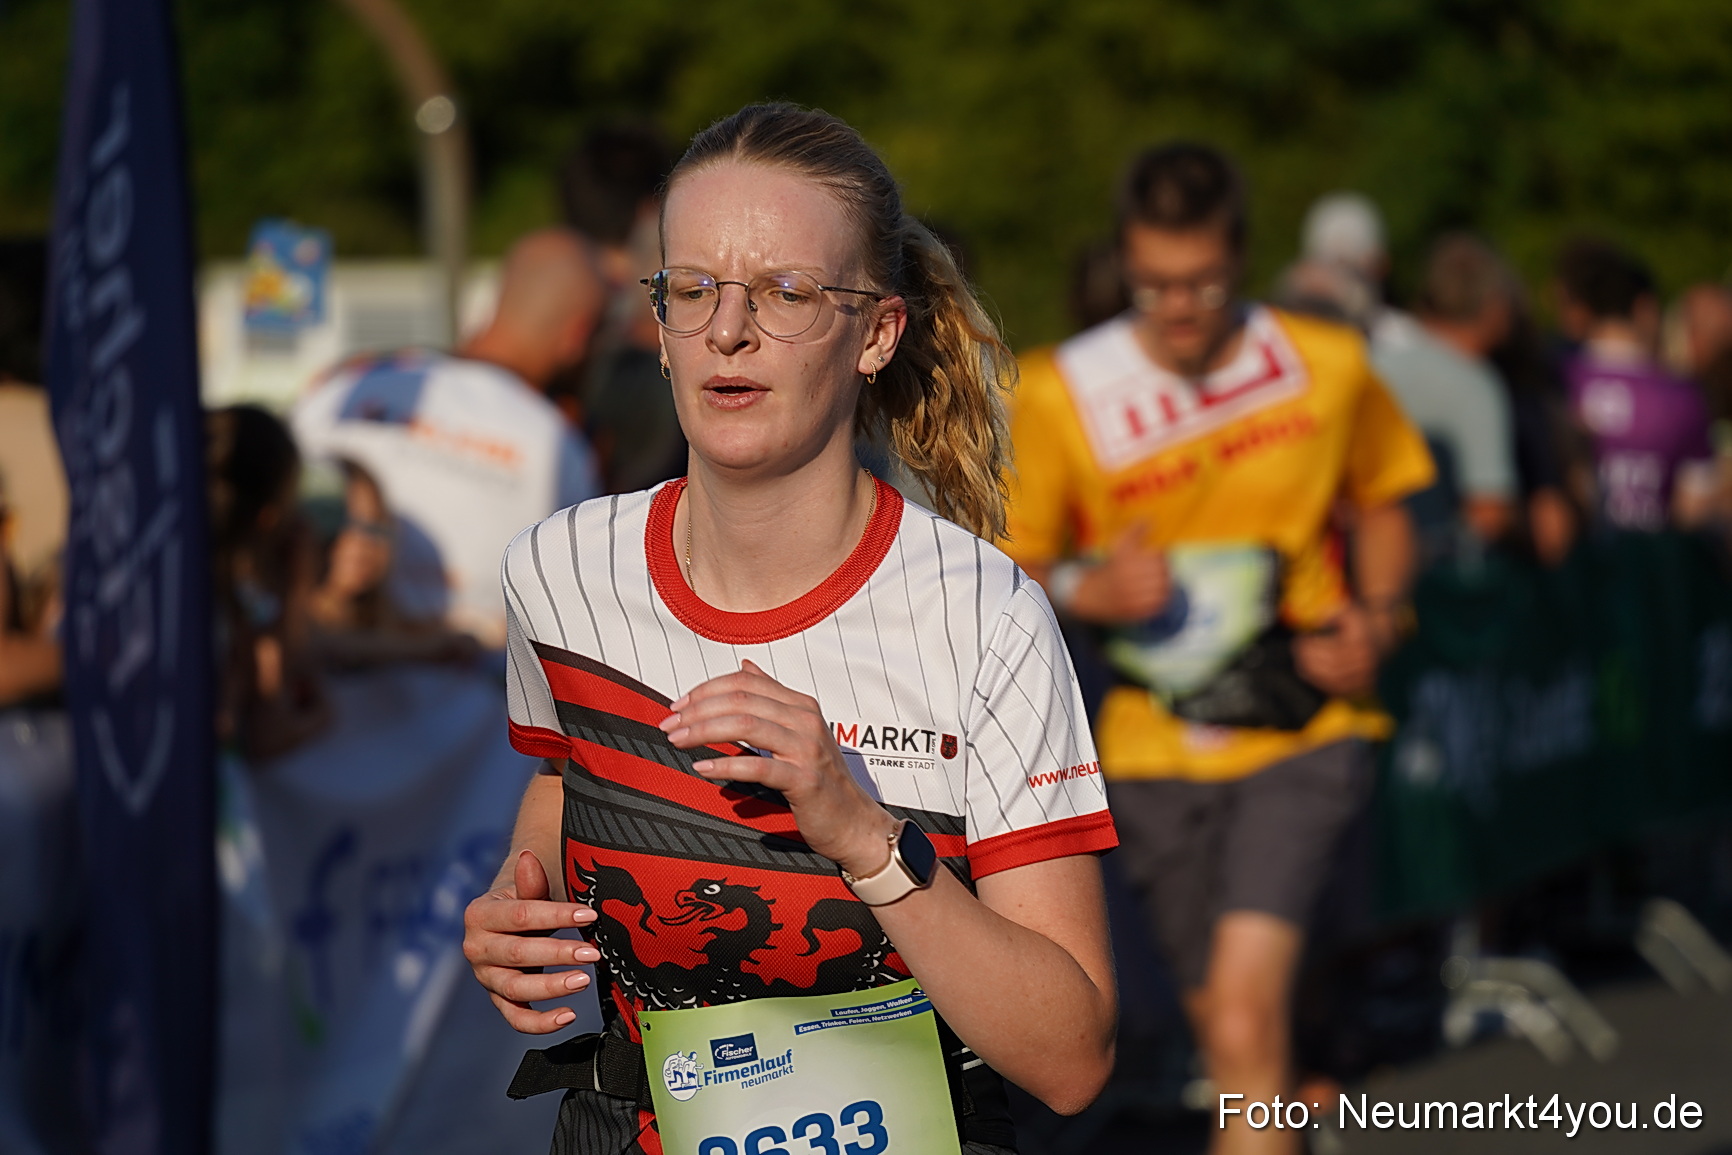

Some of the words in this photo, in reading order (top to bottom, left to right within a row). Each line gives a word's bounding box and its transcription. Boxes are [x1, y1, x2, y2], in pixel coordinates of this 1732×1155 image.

[829, 722, 936, 754] MARKT
[869, 757, 905, 768] STARKE
[907, 760, 935, 770] STADT
[834, 1007, 860, 1016] Laufen,
[860, 1003, 886, 1014] Joggen,
[886, 997, 913, 1009] Walken
[798, 1023, 821, 1033] Essen,
[821, 1018, 848, 1028] Trinken,
[848, 1015, 872, 1024] Feiern,
[872, 1009, 913, 1022] Netzwerken
[721, 1045, 754, 1057] Fischer
[703, 1049, 793, 1086] Firmenlauf
[741, 1064, 794, 1089] neumarkt
